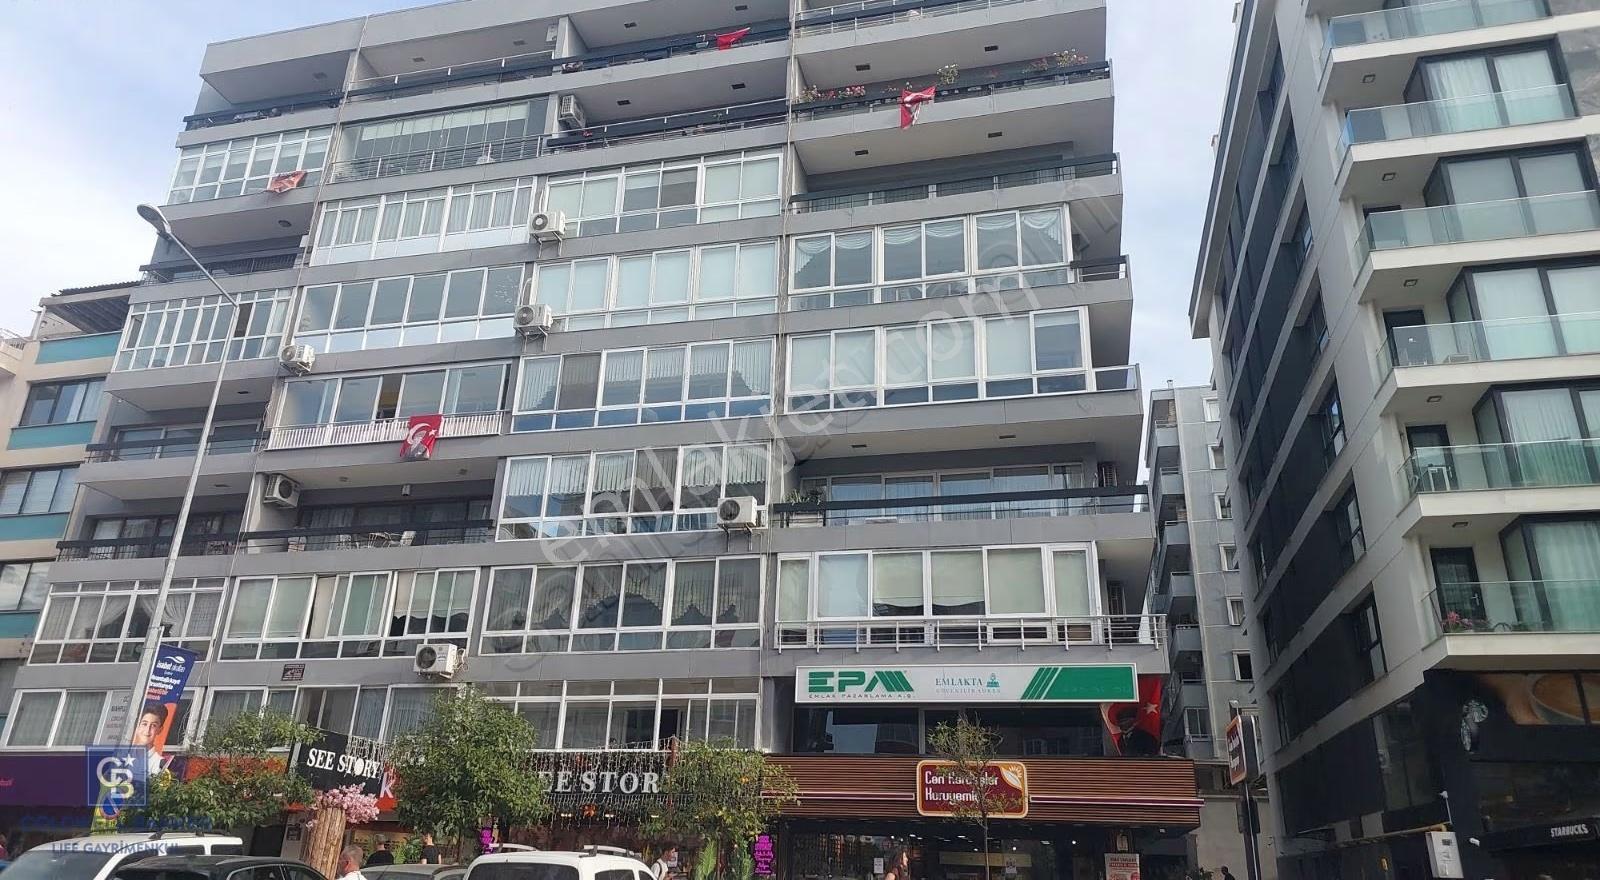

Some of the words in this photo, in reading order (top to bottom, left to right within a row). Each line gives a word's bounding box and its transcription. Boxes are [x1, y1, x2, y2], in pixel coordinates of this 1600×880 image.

[935, 678, 983, 686] EMLAKTA
[306, 748, 337, 771] SEE
[337, 754, 382, 779] STORY
[1550, 823, 1589, 838] STARBUCKS
